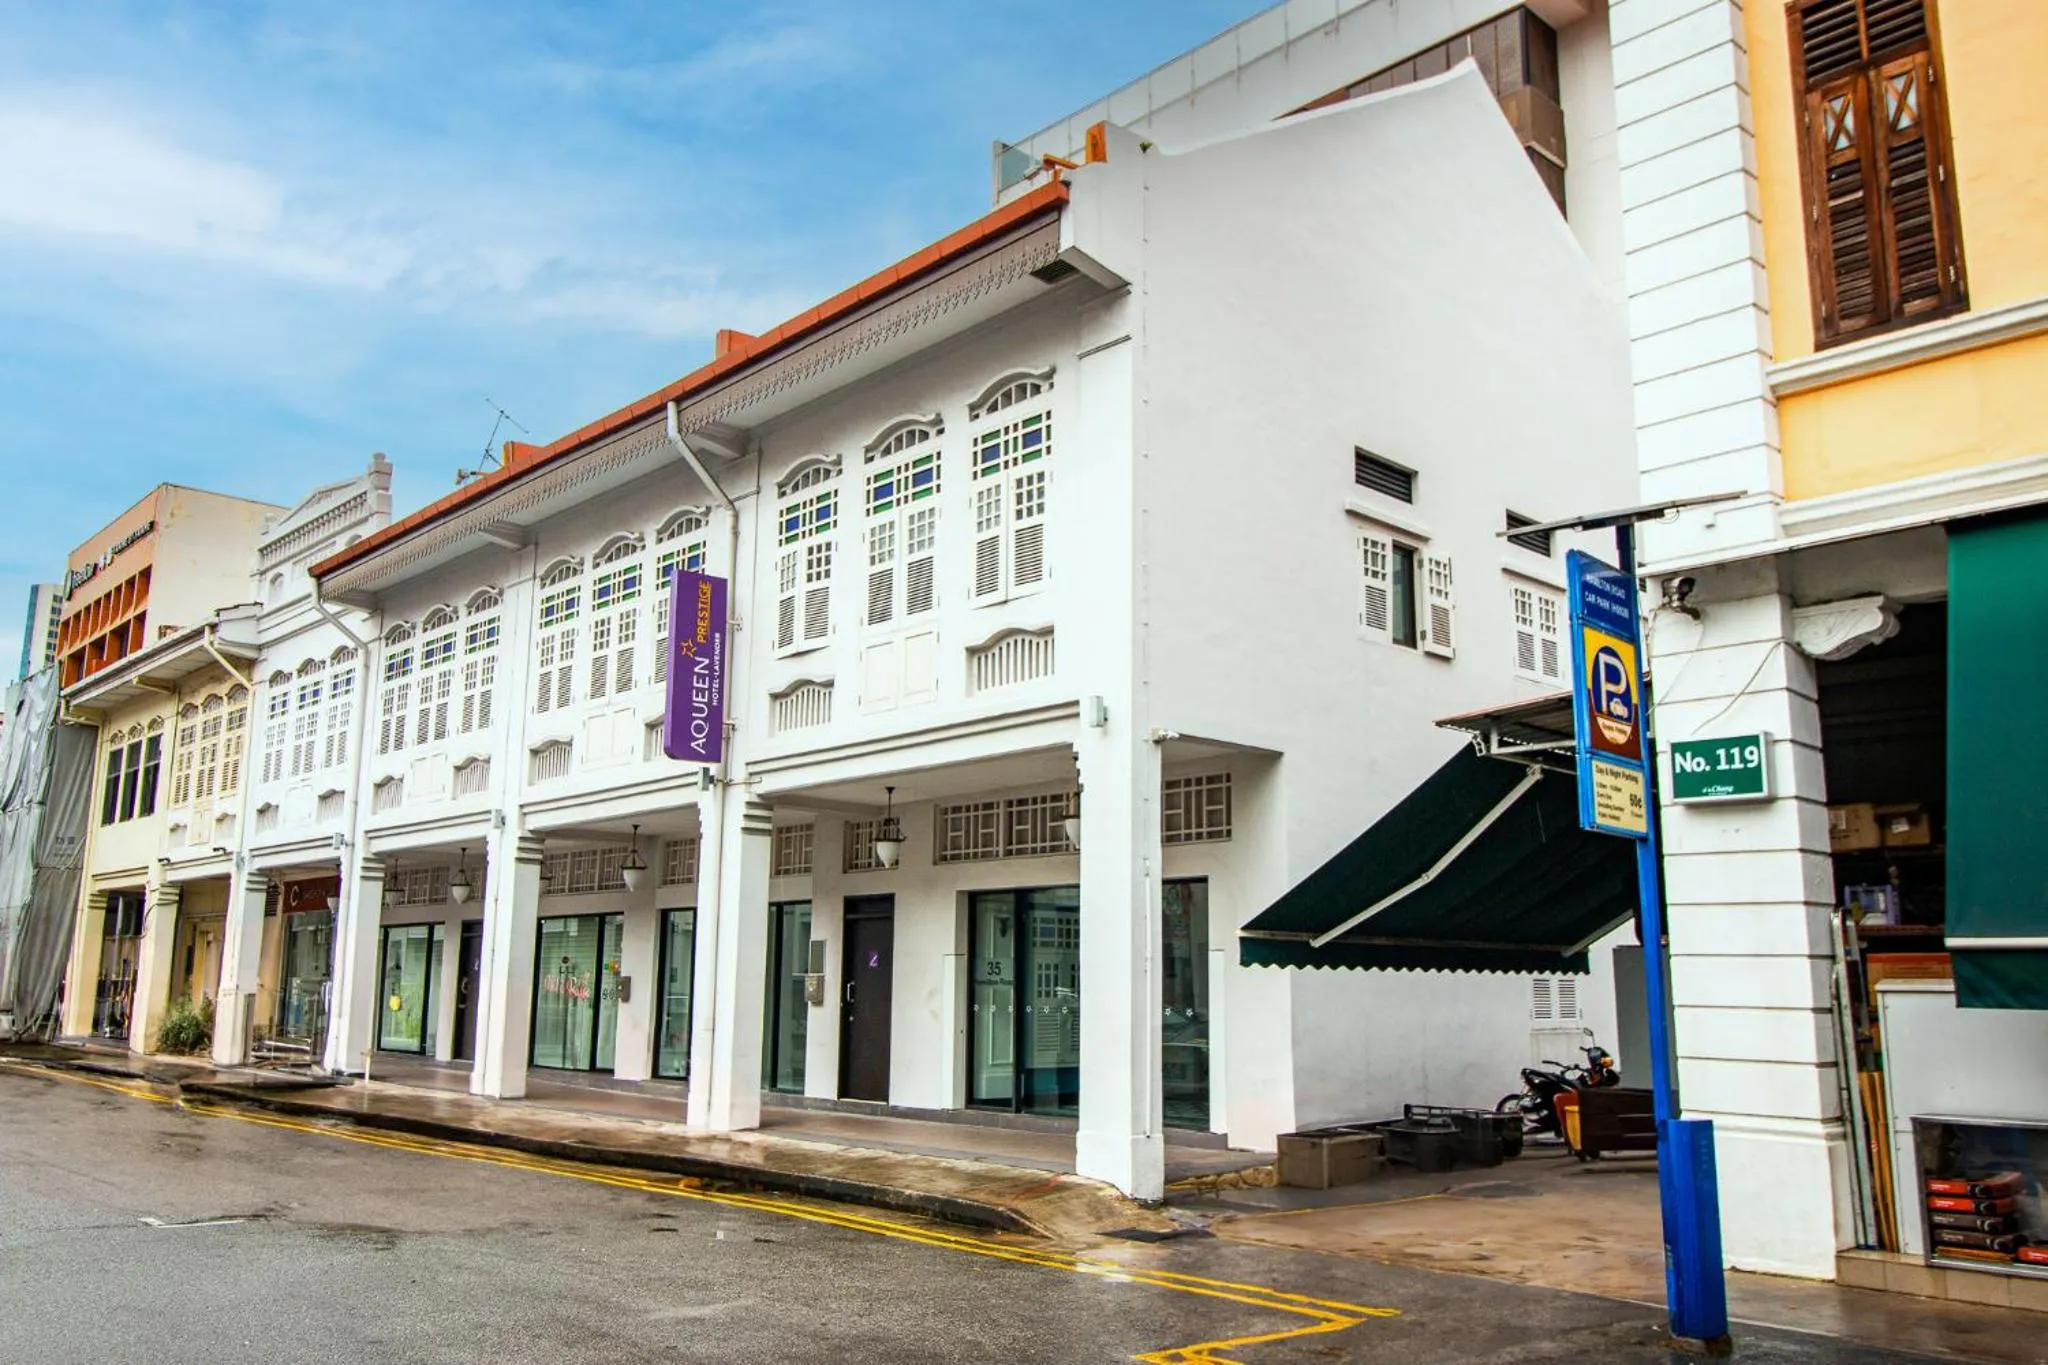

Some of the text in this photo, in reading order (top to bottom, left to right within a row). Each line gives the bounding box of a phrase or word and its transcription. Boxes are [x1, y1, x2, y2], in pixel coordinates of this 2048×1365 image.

[696, 579, 712, 644] PRESTIGE
[690, 657, 709, 755] AQUEEN
[1598, 652, 1627, 716] P
[1674, 745, 1760, 774] No. 119
[987, 961, 1002, 976] 35
